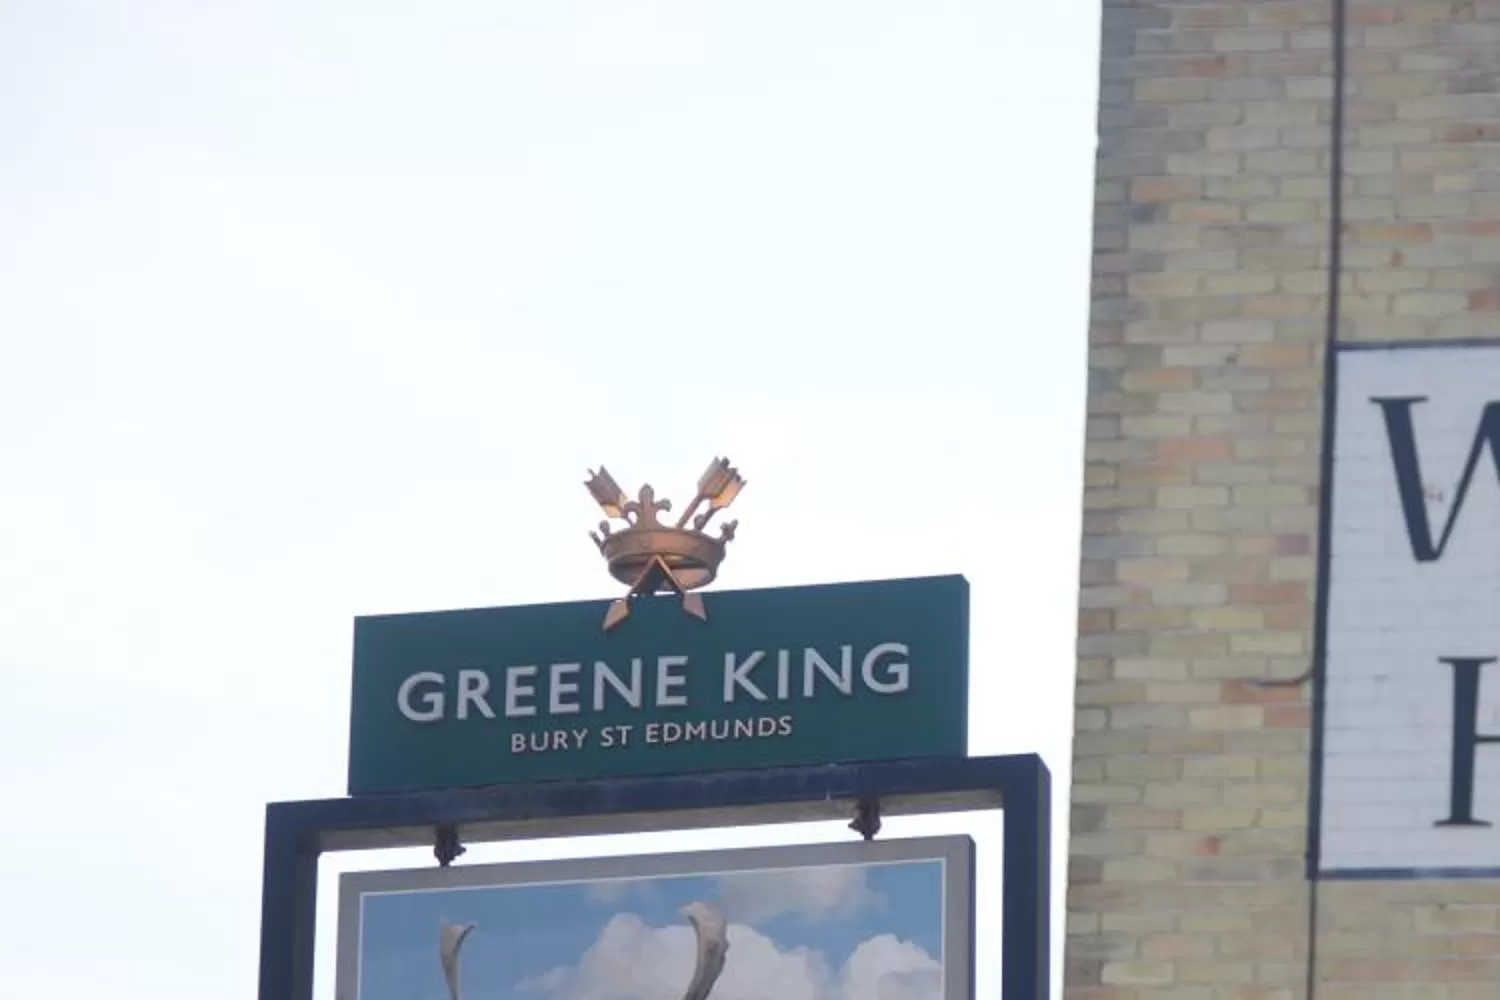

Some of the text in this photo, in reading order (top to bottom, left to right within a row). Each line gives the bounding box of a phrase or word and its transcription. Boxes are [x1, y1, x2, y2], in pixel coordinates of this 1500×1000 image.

[396, 642, 911, 722] GREENE KING
[510, 715, 794, 753] BURY ST EDMUNDS
